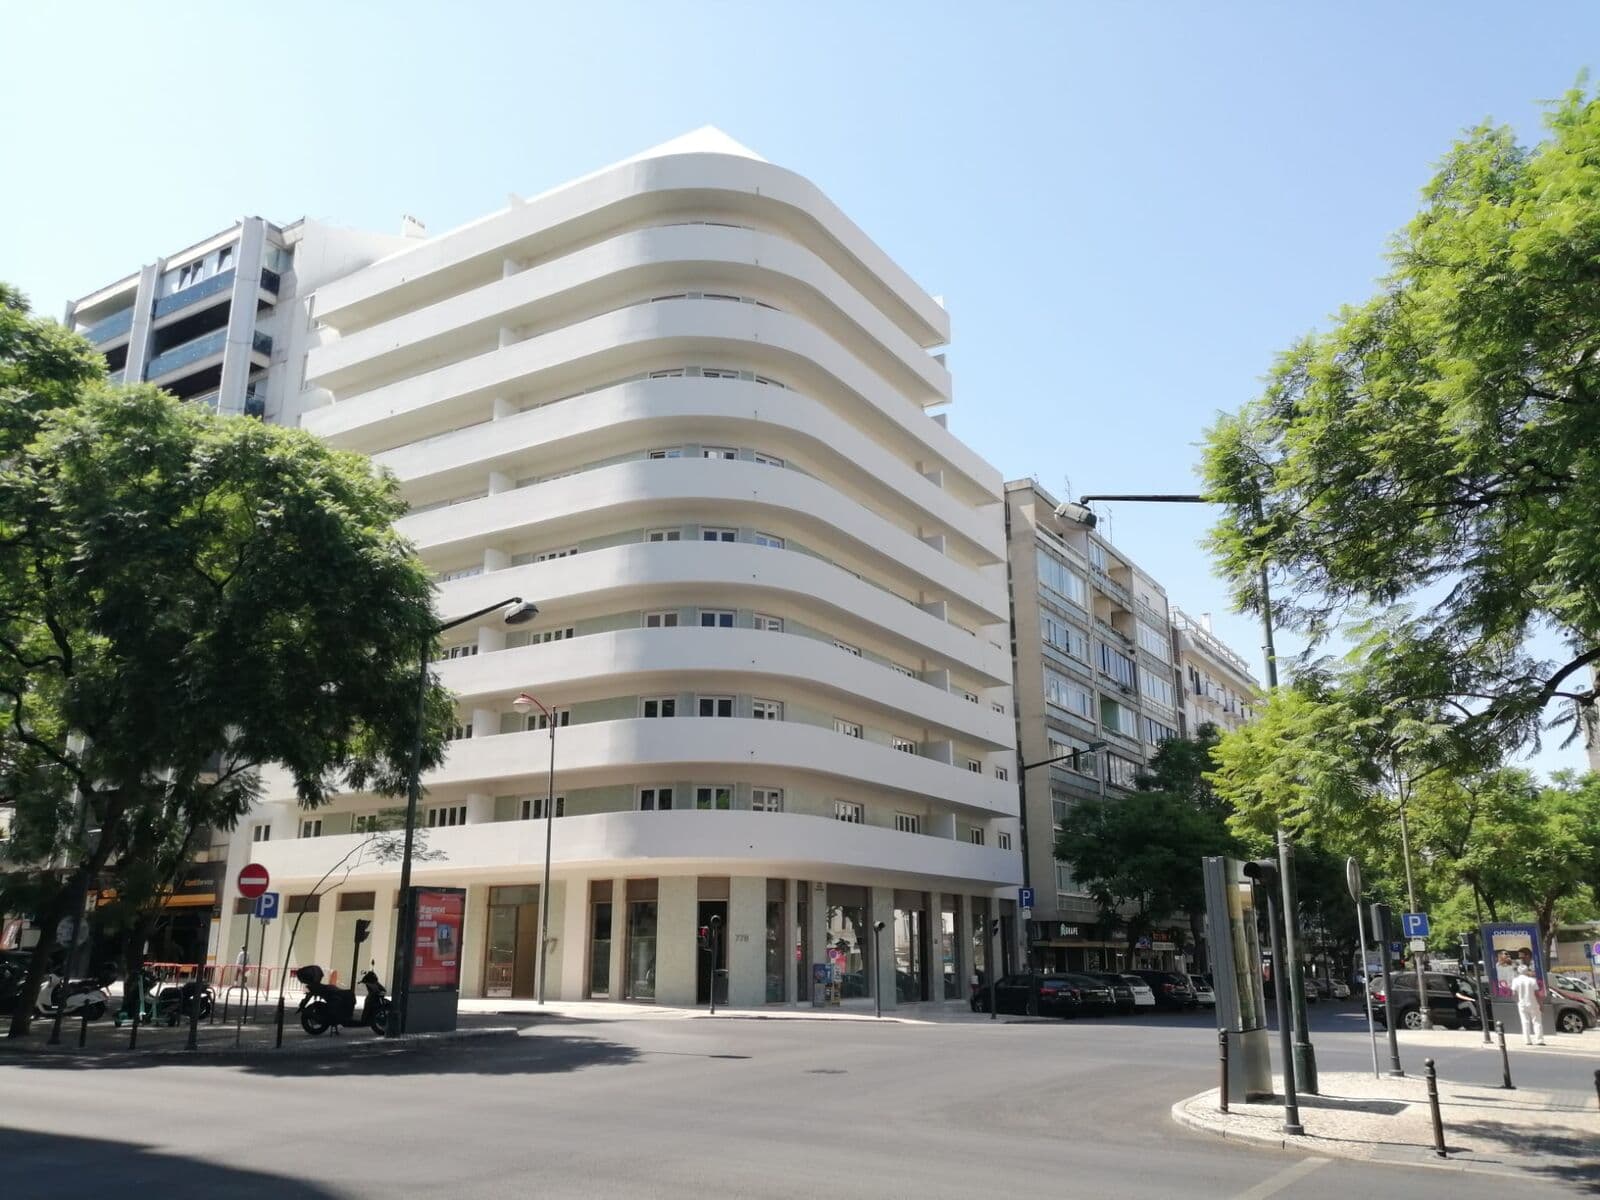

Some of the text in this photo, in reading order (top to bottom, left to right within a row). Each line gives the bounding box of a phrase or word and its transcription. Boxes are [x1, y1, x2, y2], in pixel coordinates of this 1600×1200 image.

[261, 894, 275, 916] P
[1023, 890, 1031, 906] P
[1409, 915, 1421, 935] P
